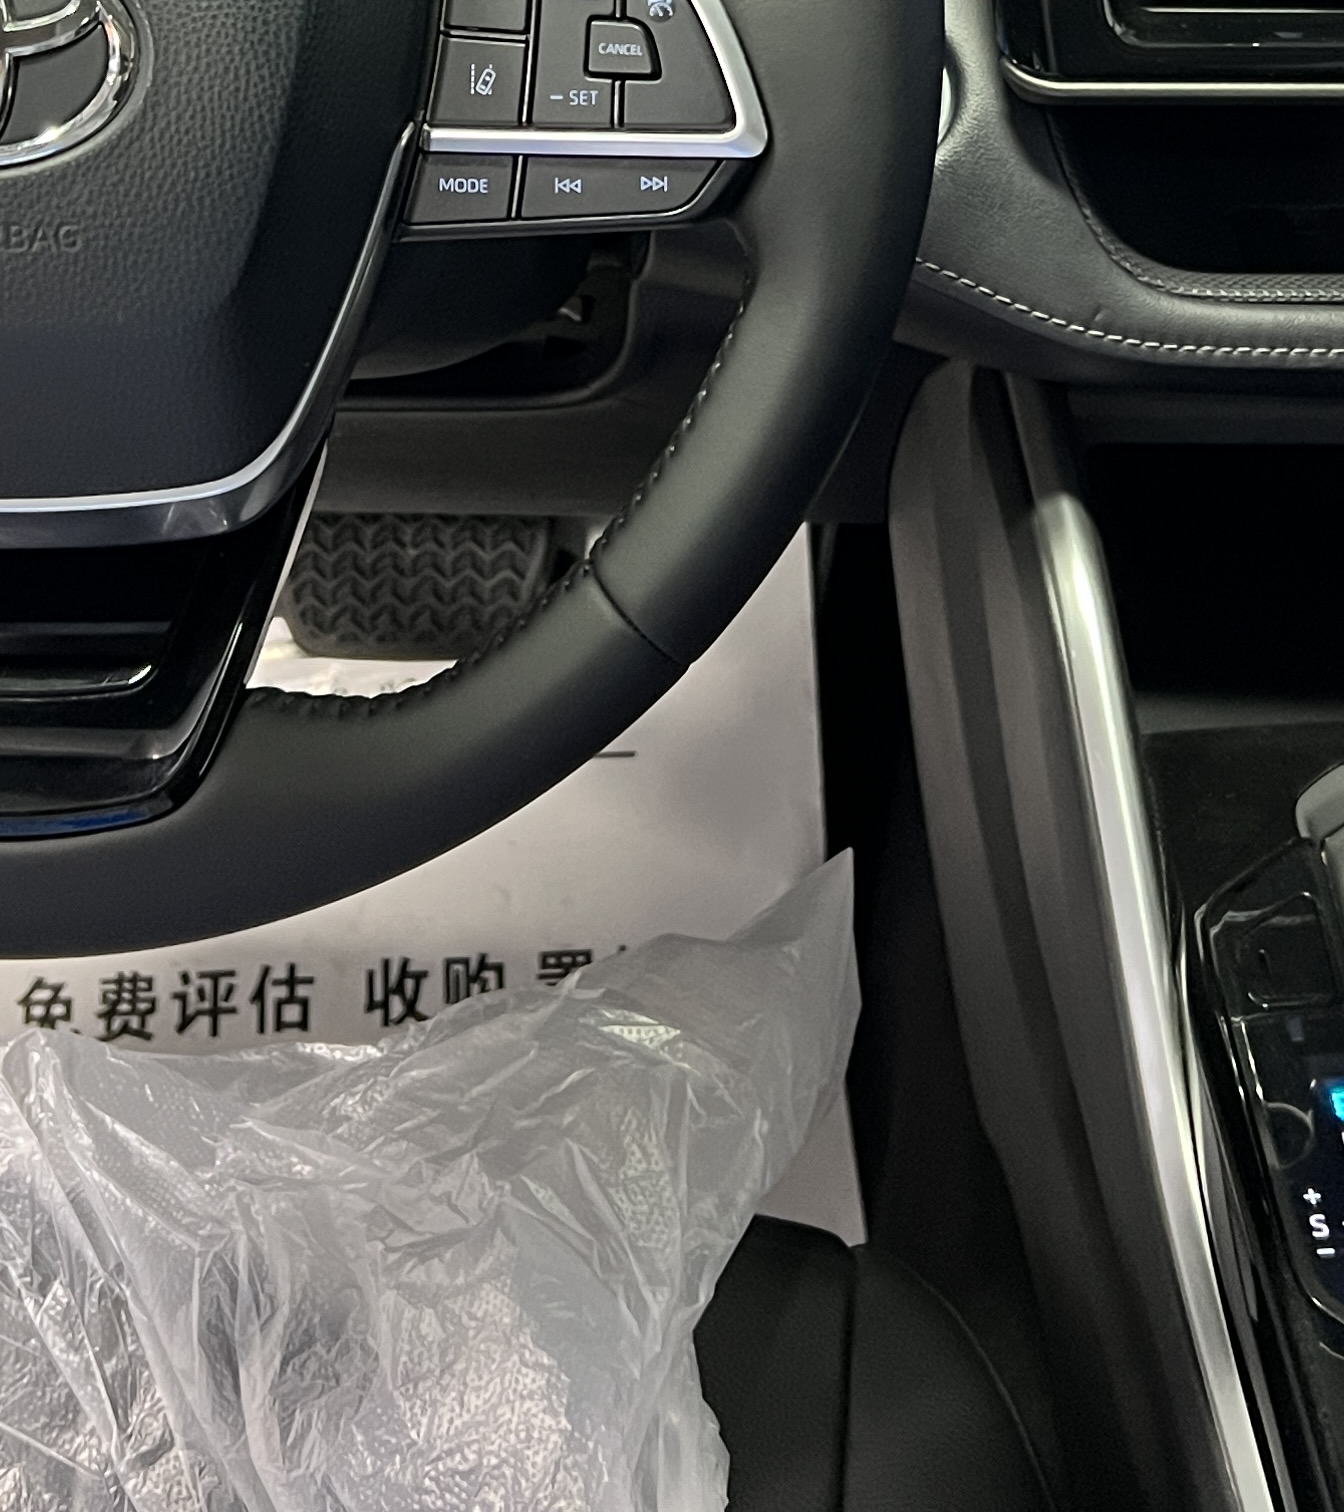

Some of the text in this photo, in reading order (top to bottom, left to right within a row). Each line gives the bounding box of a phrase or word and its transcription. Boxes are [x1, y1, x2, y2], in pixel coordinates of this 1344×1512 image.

[598, 43, 643, 56] CANCEL
[439, 178, 489, 193] MODE
[18, 962, 316, 1041] 免费评估
[1309, 1213, 1330, 1238] S
